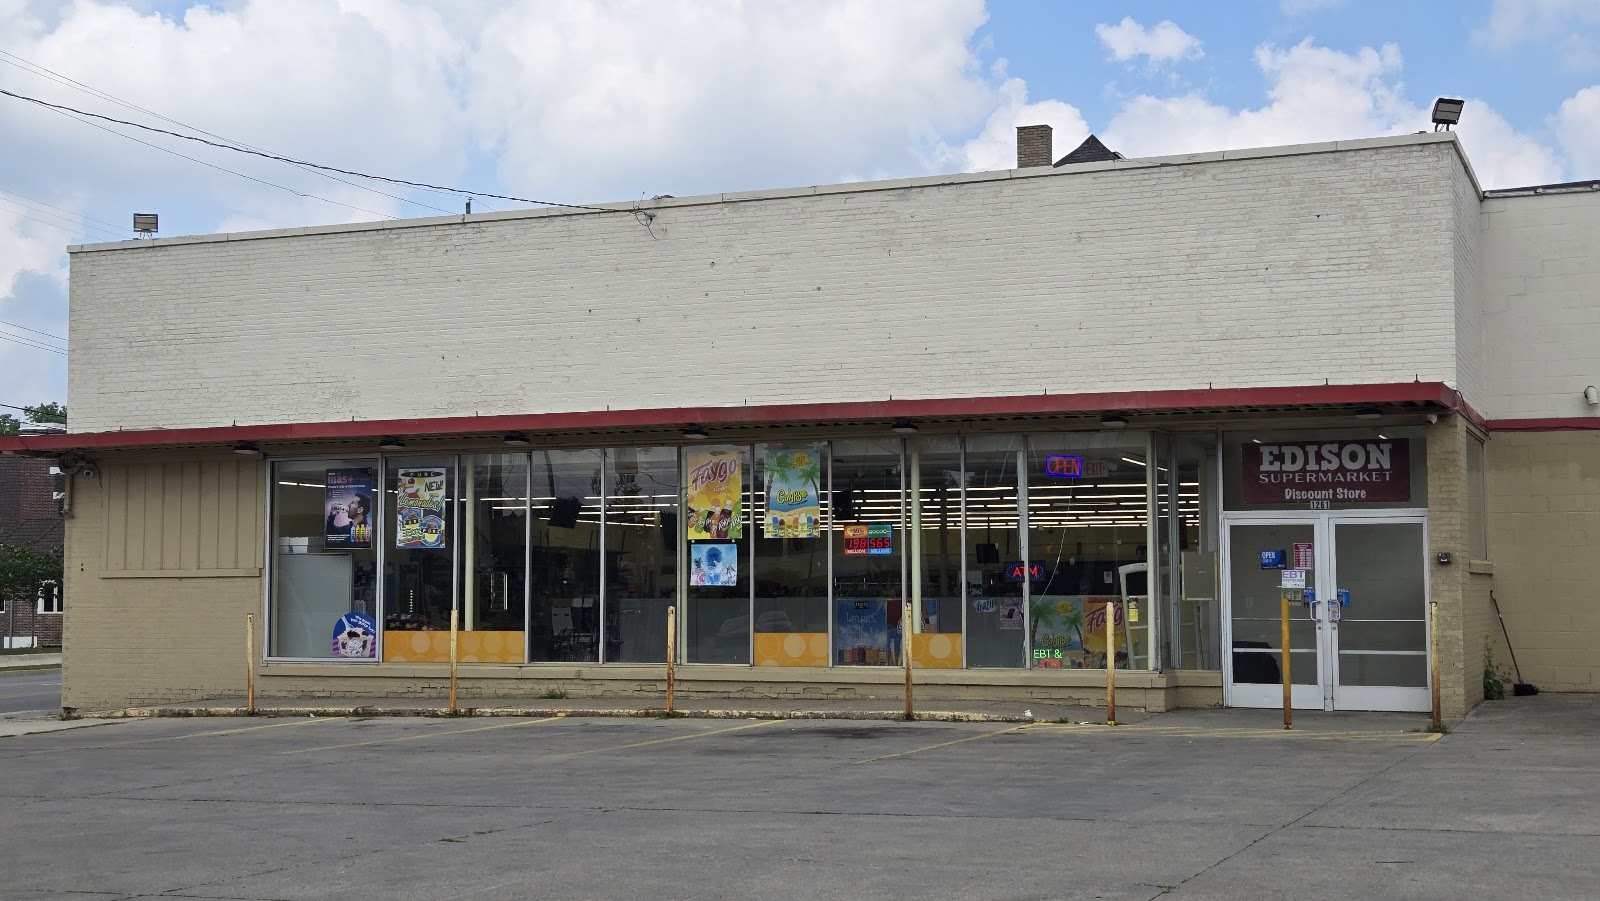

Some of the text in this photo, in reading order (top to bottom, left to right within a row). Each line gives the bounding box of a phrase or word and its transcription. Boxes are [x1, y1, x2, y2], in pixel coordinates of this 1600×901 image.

[1259, 443, 1392, 472] EDISON
[1048, 457, 1080, 475] OPEN
[1086, 462, 1104, 476] EXIT
[690, 459, 737, 492] Faygo
[1259, 471, 1392, 483] SUPERMARKET
[424, 480, 443, 492] NEW!
[776, 488, 808, 504] Calypso
[1285, 487, 1367, 500] Discount Store
[1311, 501, 1330, 509] 1261
[850, 538, 866, 549] 198
[869, 538, 890, 548] 565
[1282, 570, 1304, 578] EBT
[976, 599, 994, 613] frazil
[1041, 633, 1071, 646] Calypso
[1033, 649, 1063, 660] EBT &
